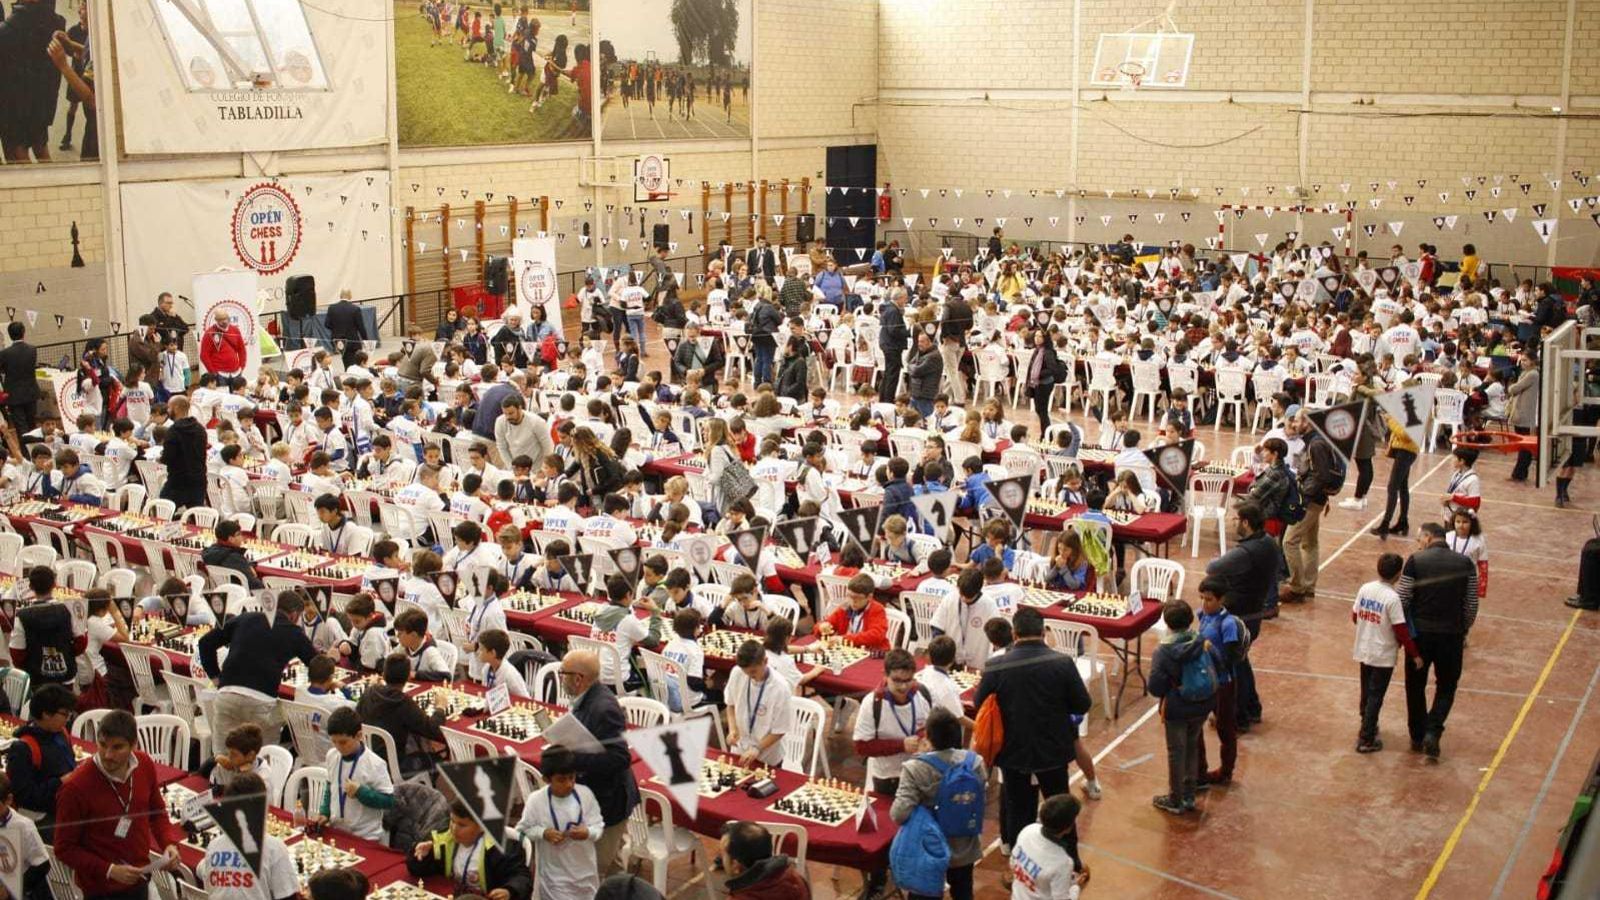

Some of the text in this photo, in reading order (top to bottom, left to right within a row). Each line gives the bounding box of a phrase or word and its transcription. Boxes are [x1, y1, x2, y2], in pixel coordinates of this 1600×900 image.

[218, 106, 303, 120] TABLADILLA
[250, 226, 282, 239] CHESS
[544, 517, 568, 528] OPEN
[588, 519, 616, 530] OPEN
[1360, 597, 1384, 613] OPEN
[210, 851, 247, 867] OPE
[209, 869, 254, 888] CHESS
